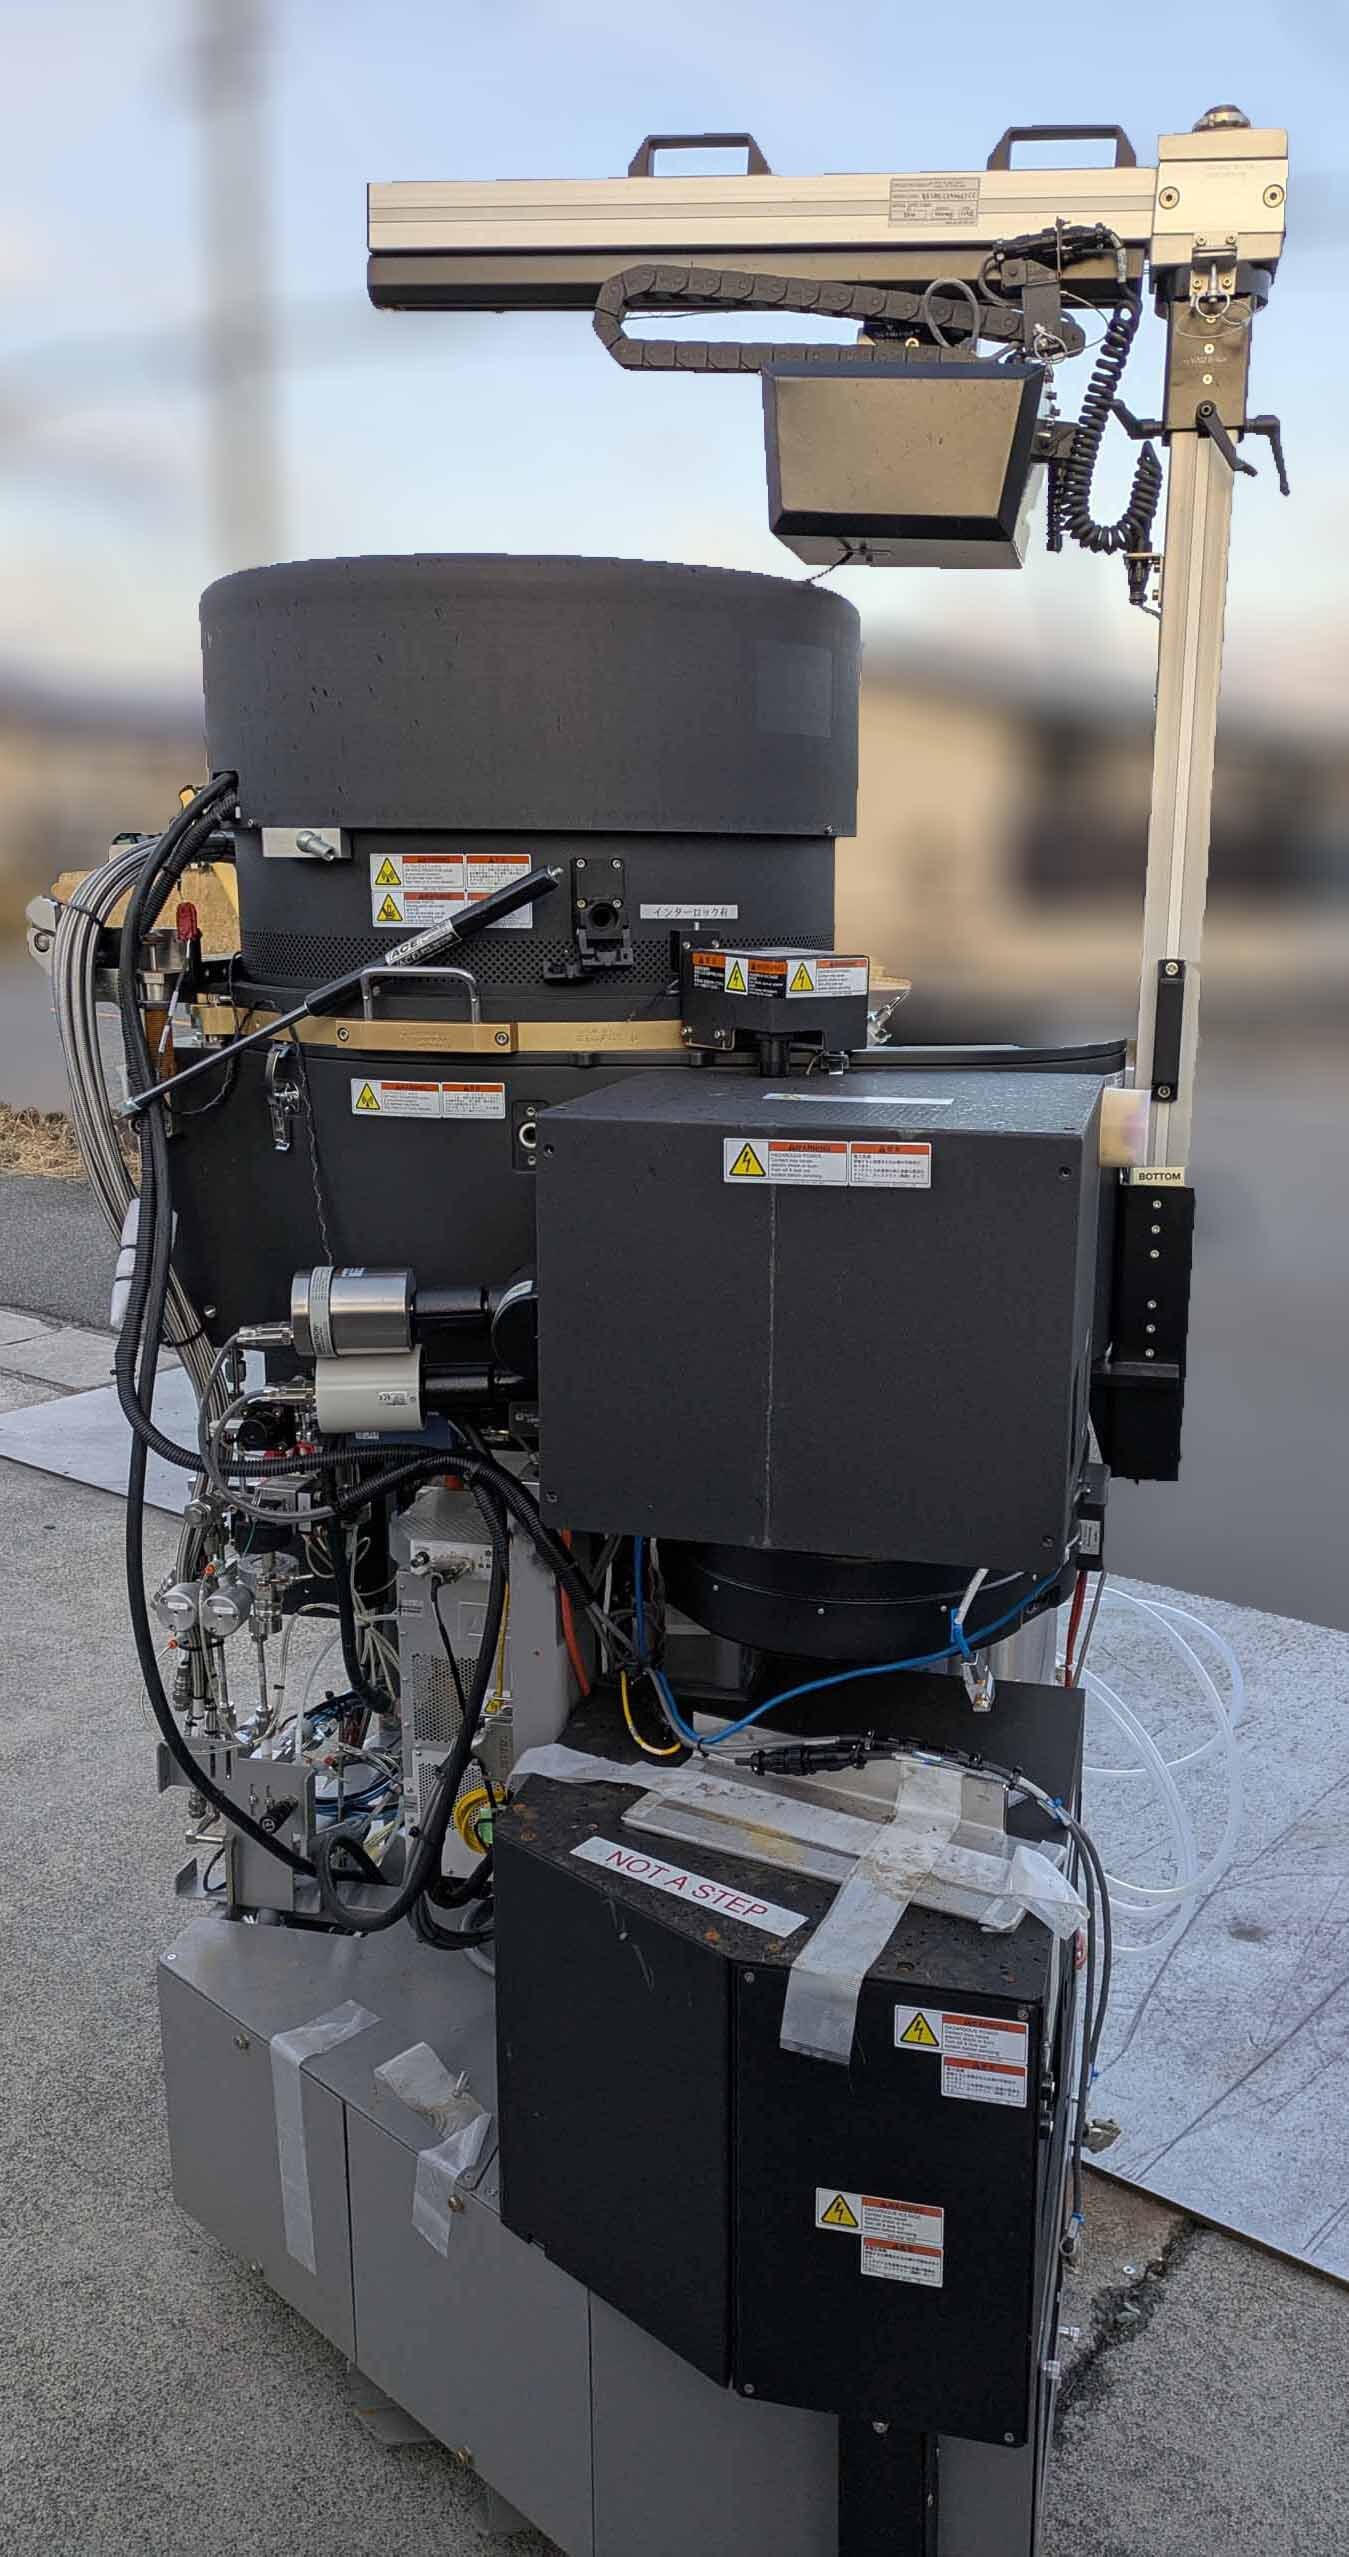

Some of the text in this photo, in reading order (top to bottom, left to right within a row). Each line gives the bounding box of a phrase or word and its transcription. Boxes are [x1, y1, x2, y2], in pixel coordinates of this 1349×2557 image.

[1139, 1172, 1181, 1181] BOTTOM
[606, 1851, 769, 1917] NOT A STEP
